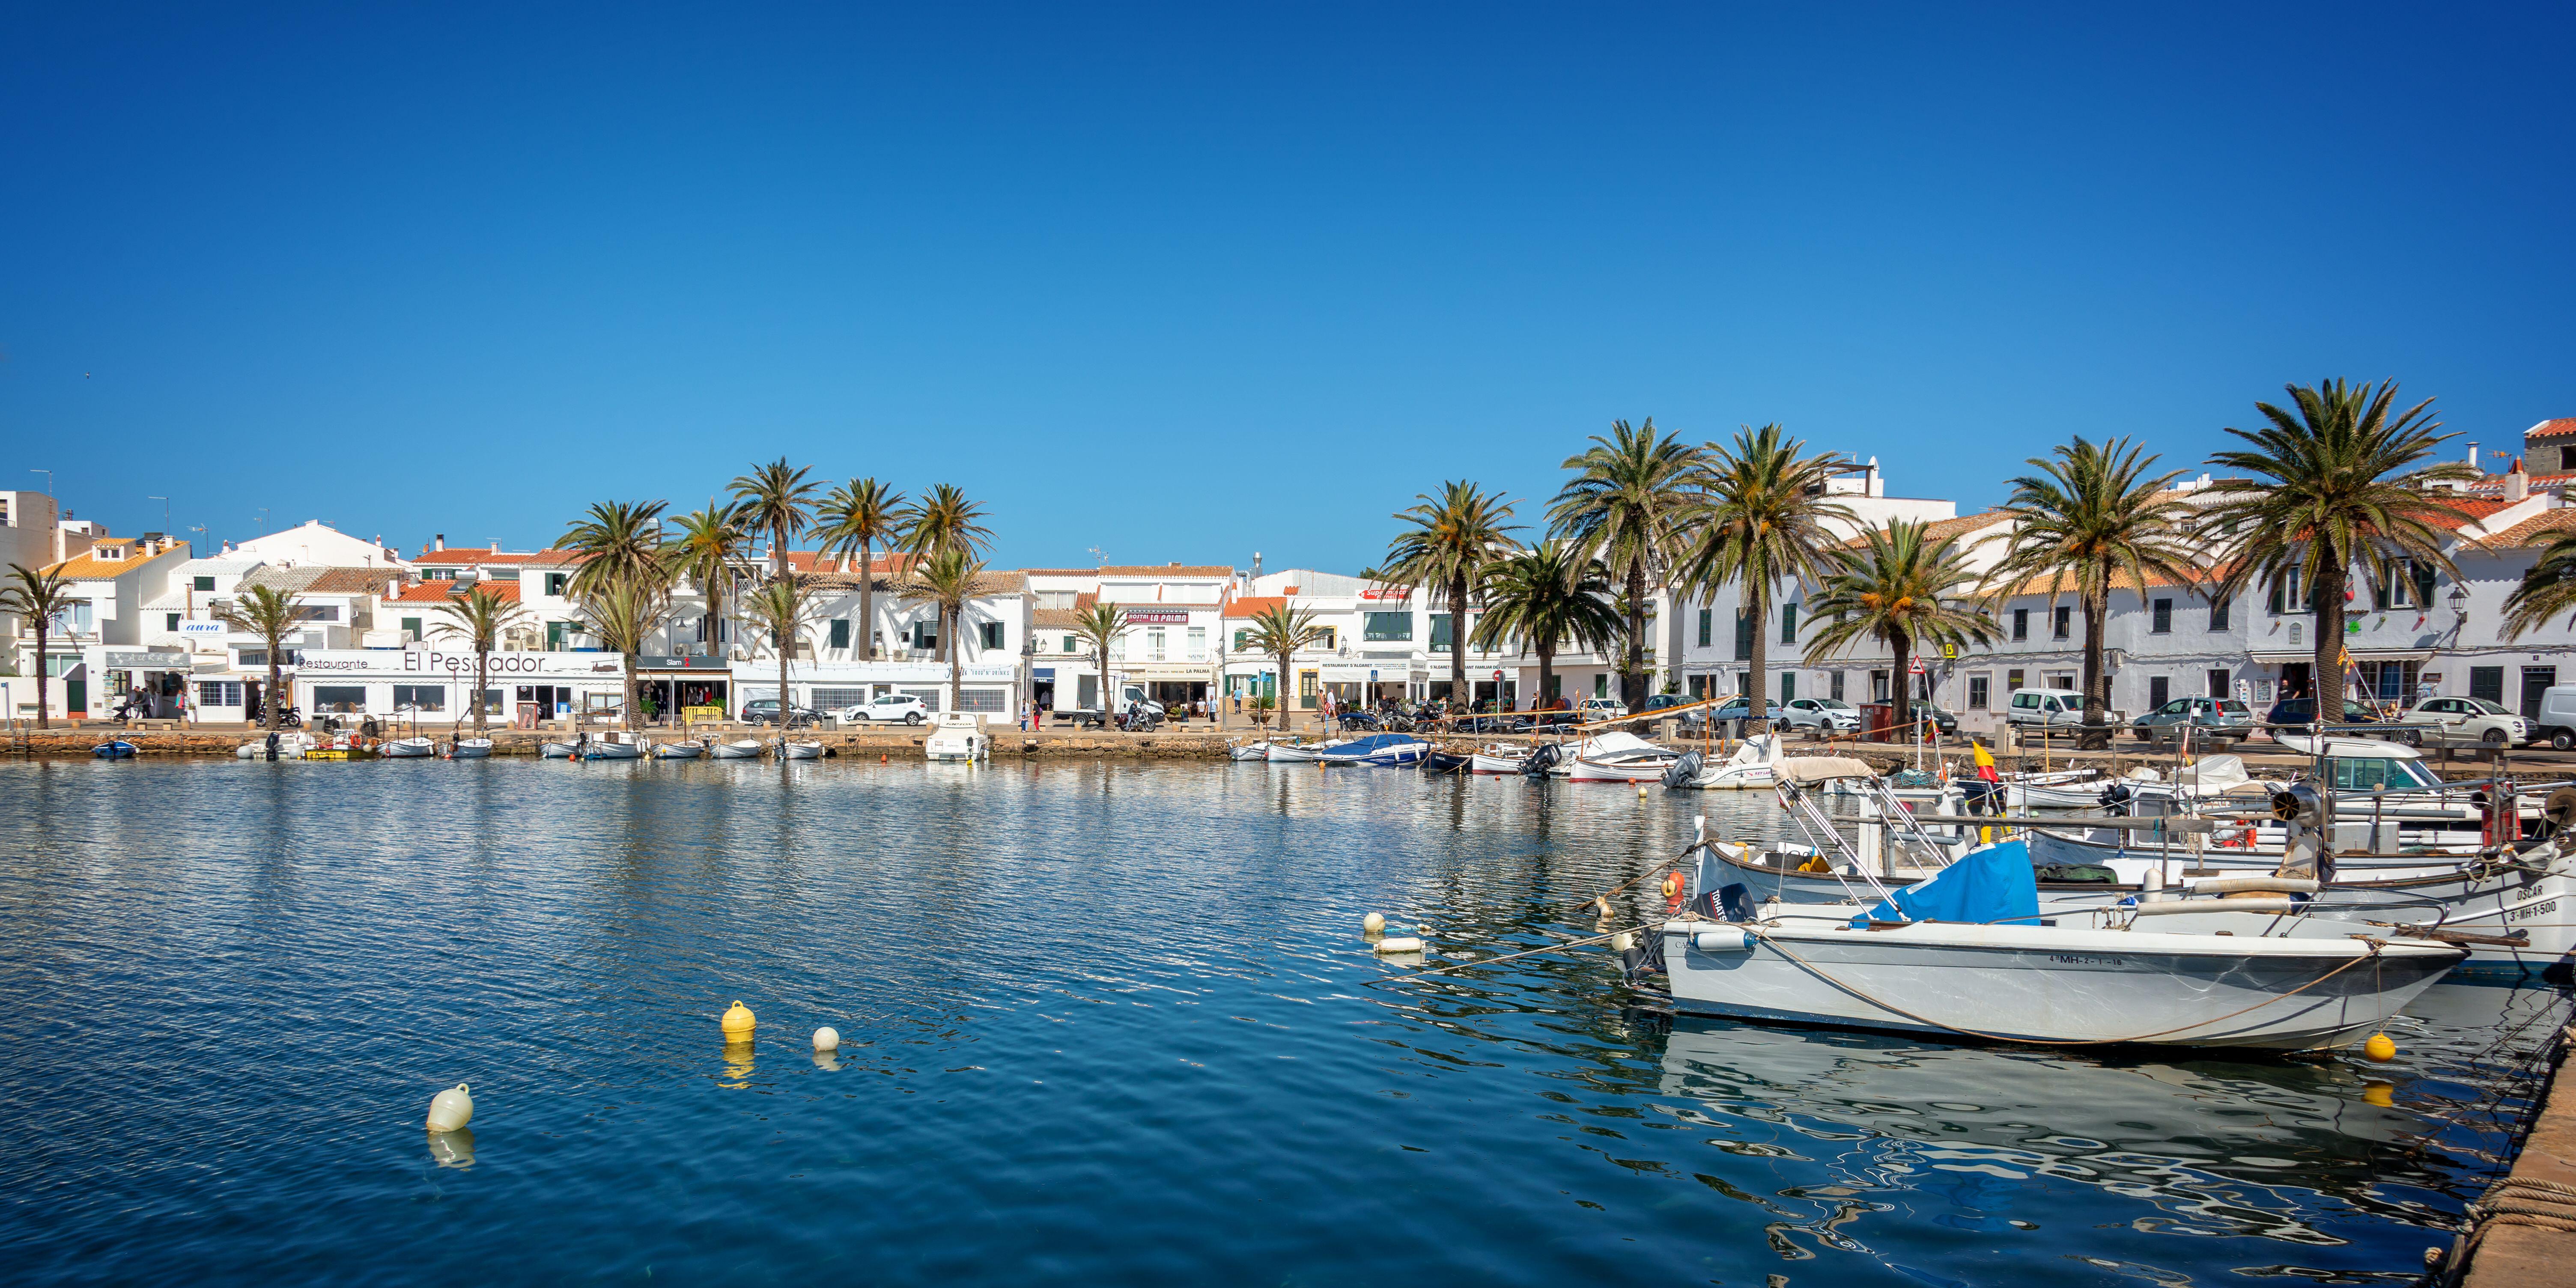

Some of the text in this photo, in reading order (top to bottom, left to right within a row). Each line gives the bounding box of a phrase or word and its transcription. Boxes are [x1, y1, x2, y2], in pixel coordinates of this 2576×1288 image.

[129, 653, 164, 662] AURA
[299, 659, 368, 668] Restaurante
[405, 652, 420, 671] El
[2517, 885, 2543, 900] OSCAR
[1711, 889, 1729, 922] TOHATS
